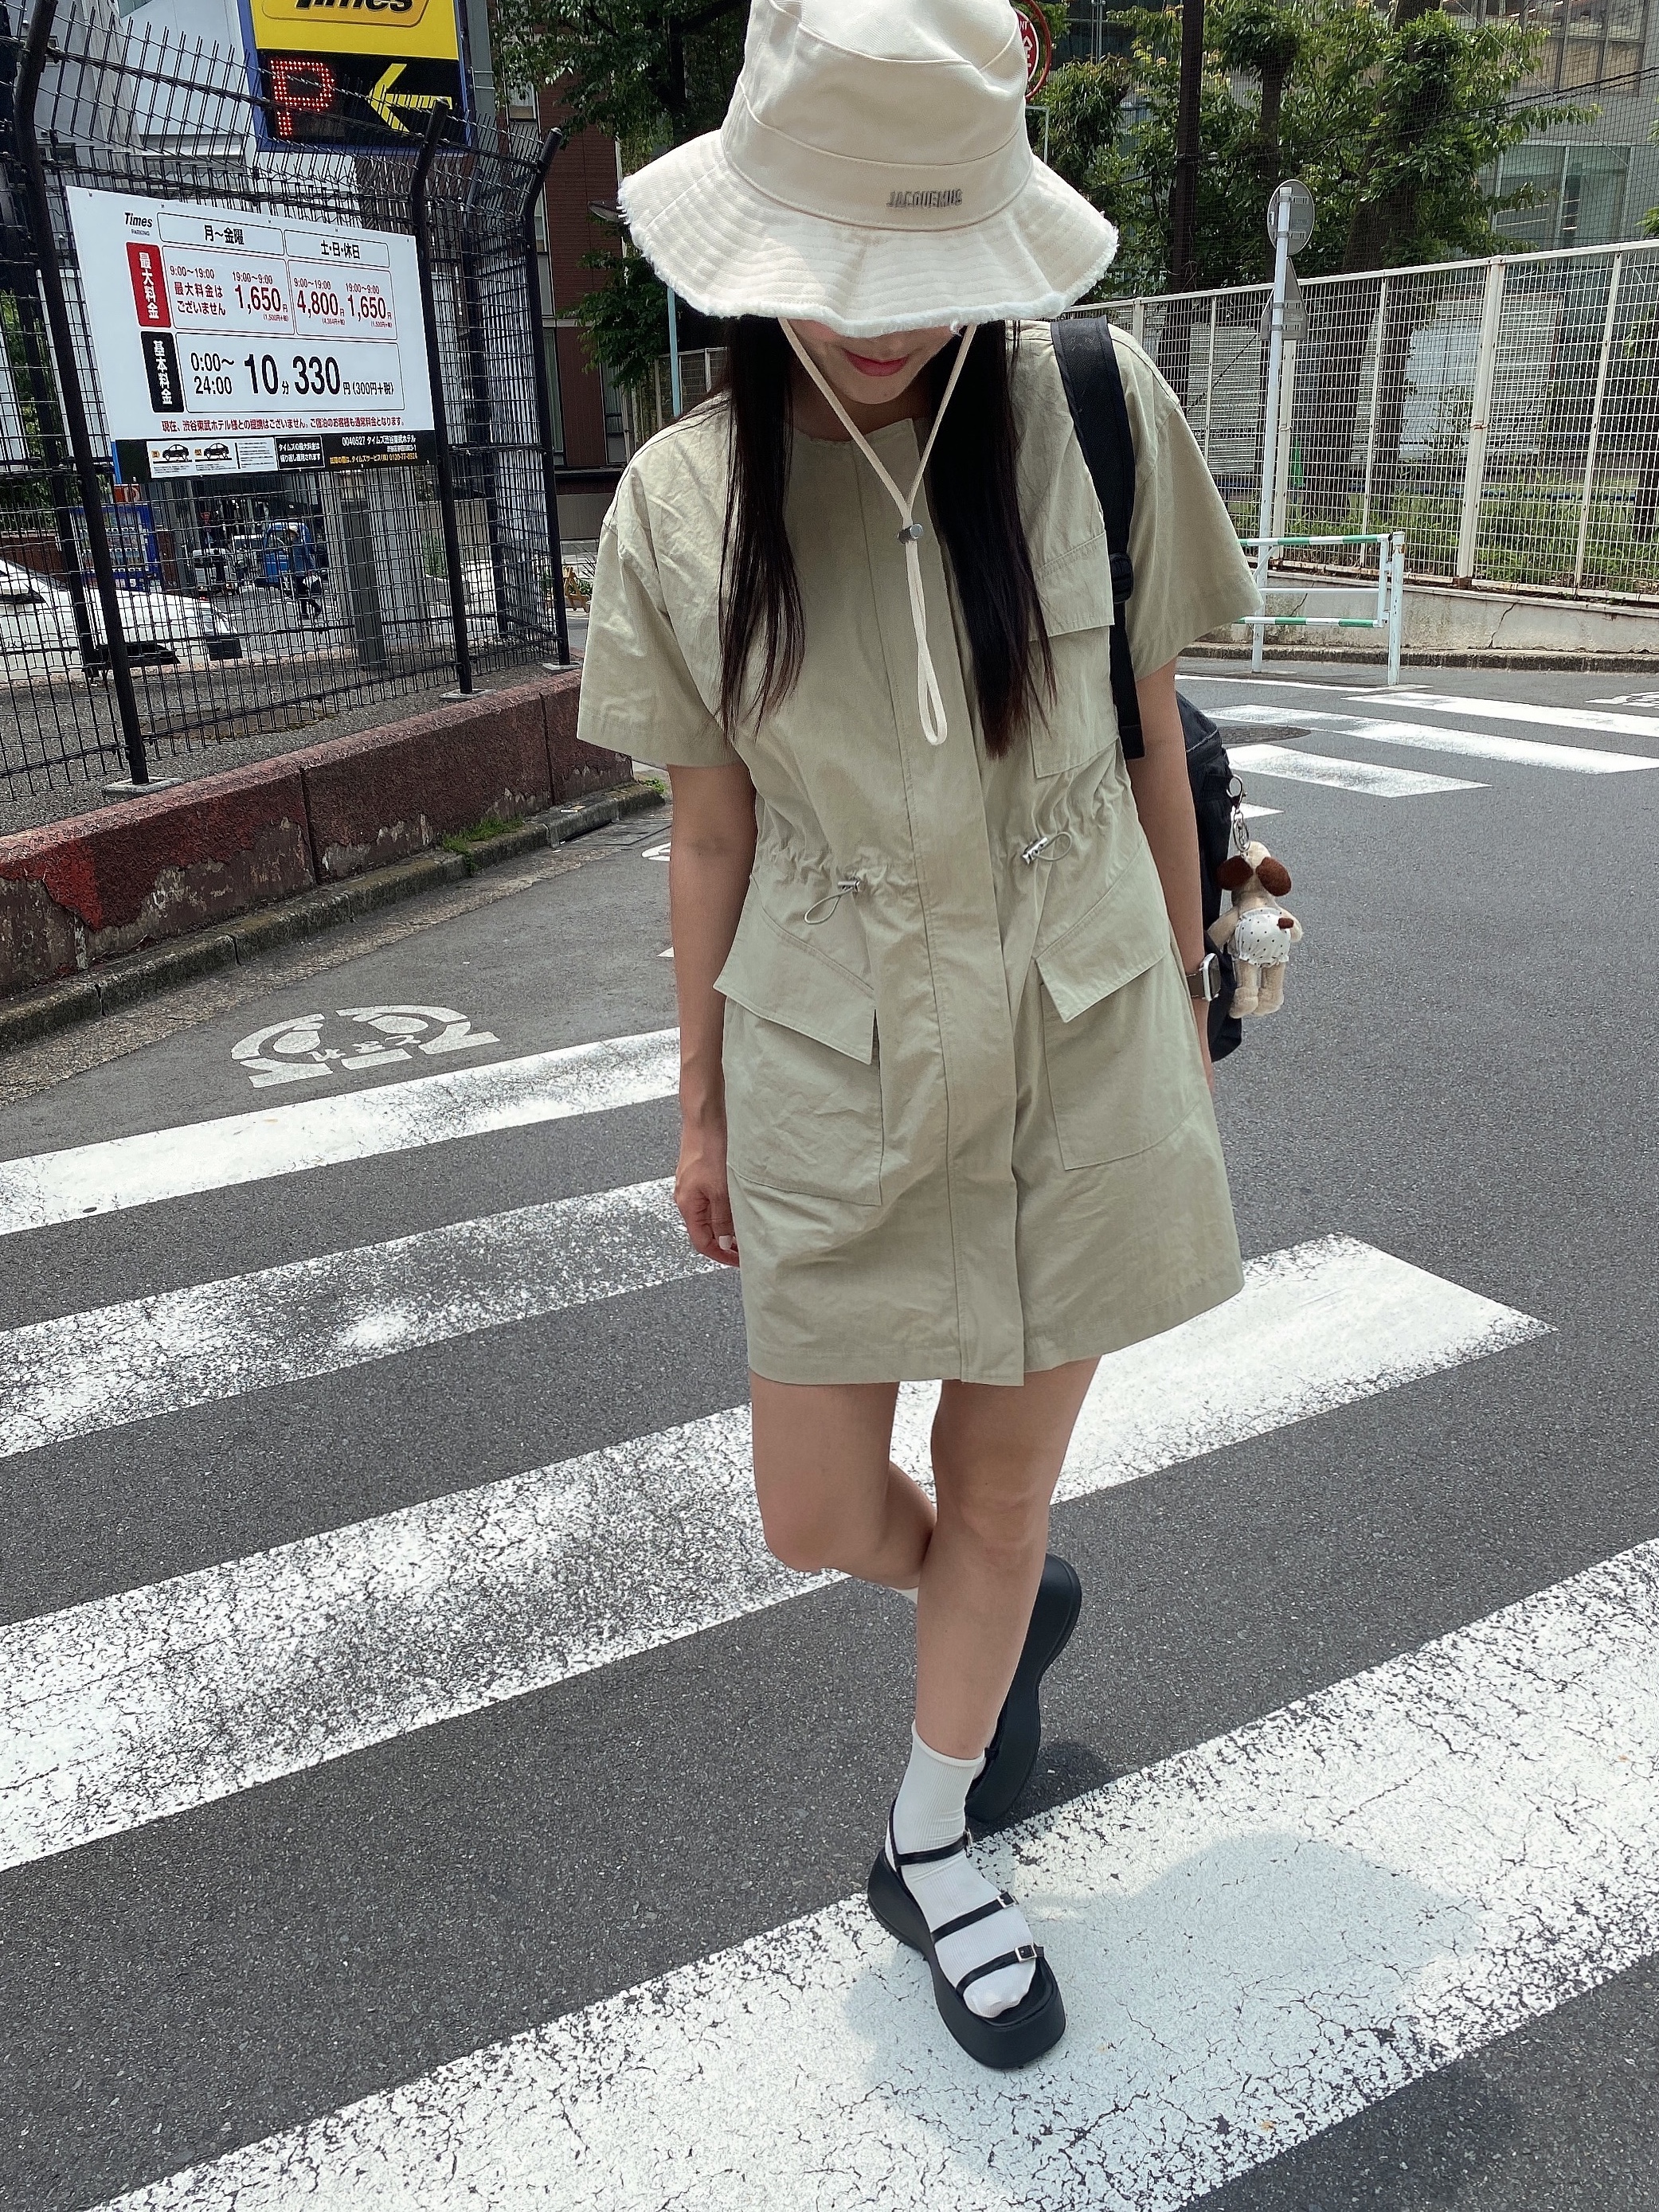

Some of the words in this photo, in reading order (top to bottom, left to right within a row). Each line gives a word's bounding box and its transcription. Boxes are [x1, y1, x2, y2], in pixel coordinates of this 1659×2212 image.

[269, 60, 335, 136] P
[886, 189, 963, 208] JACQUEMUS
[124, 212, 153, 228] Times
[139, 252, 159, 319] 最大料金
[174, 281, 224, 299] 最大料金は
[177, 299, 226, 316] ございません
[153, 340, 173, 405] 基本料金
[194, 376, 233, 395] 24:00
[342, 436, 366, 447] 0040527
